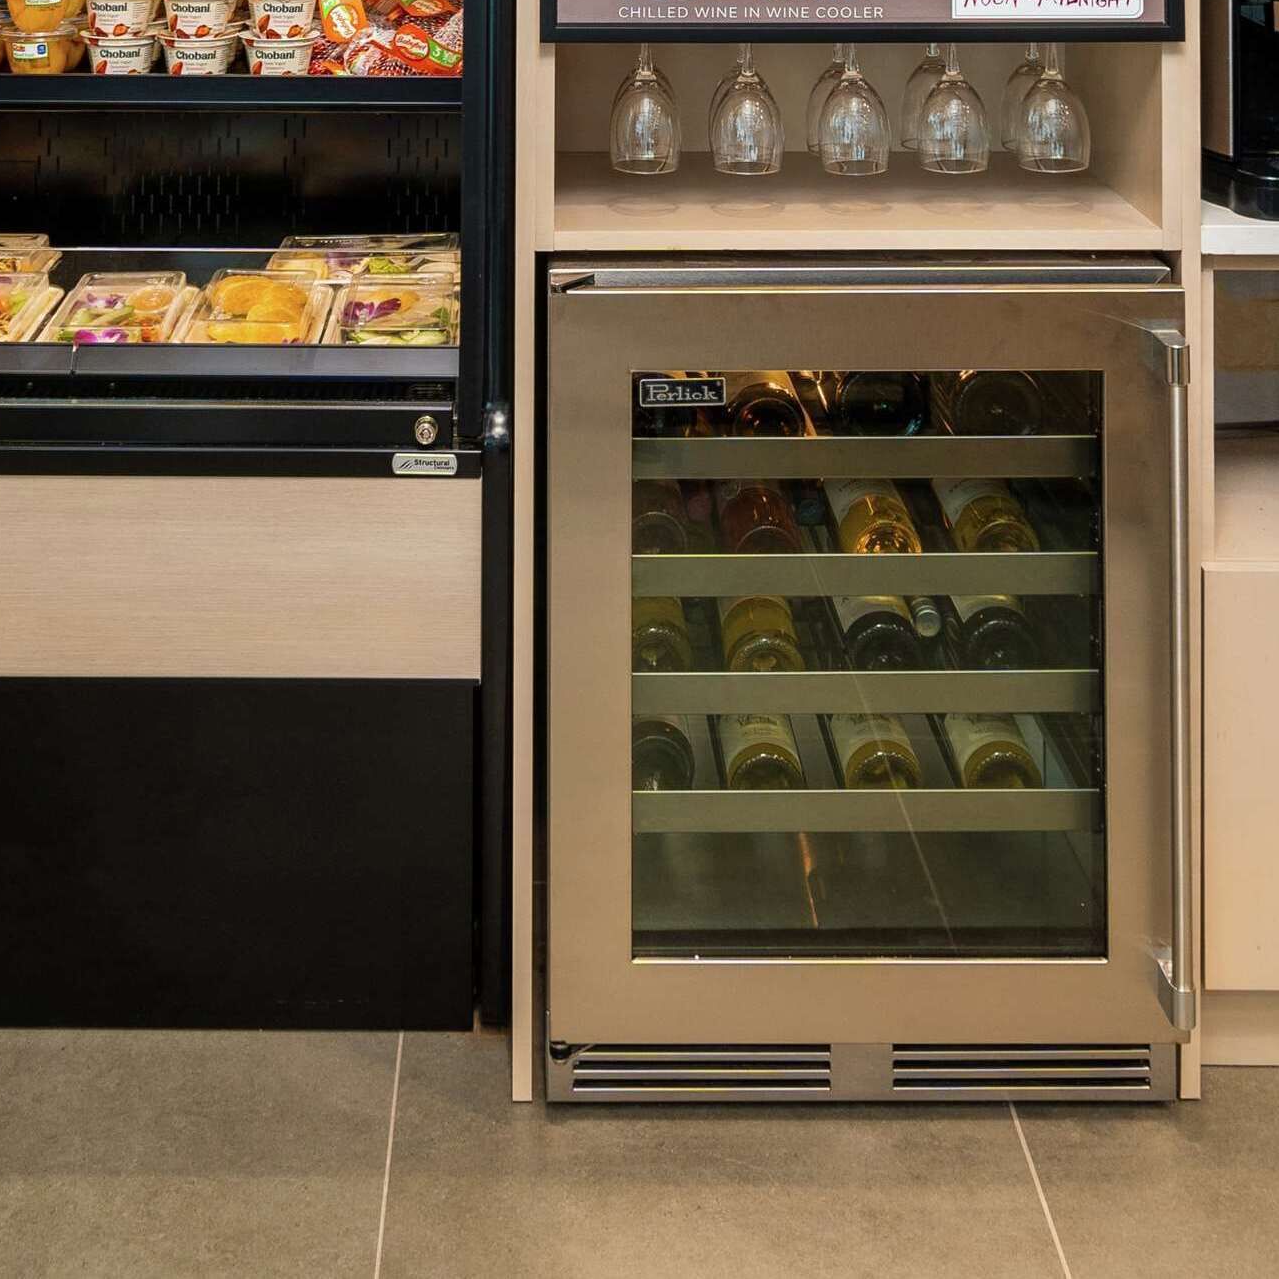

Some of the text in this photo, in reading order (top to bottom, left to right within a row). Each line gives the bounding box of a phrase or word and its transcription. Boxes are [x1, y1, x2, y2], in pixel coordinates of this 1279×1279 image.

[90, 2, 128, 12] Chobani
[171, 3, 210, 13] Chobani
[263, 3, 304, 13] Chobani
[618, 5, 884, 19] CHILLED WINE IN WINE COOLER
[100, 48, 141, 58] Chobani
[176, 50, 216, 60] Chobani
[255, 49, 296, 60] Chobani
[646, 383, 719, 403] Perlick
[414, 459, 450, 467] Structural
